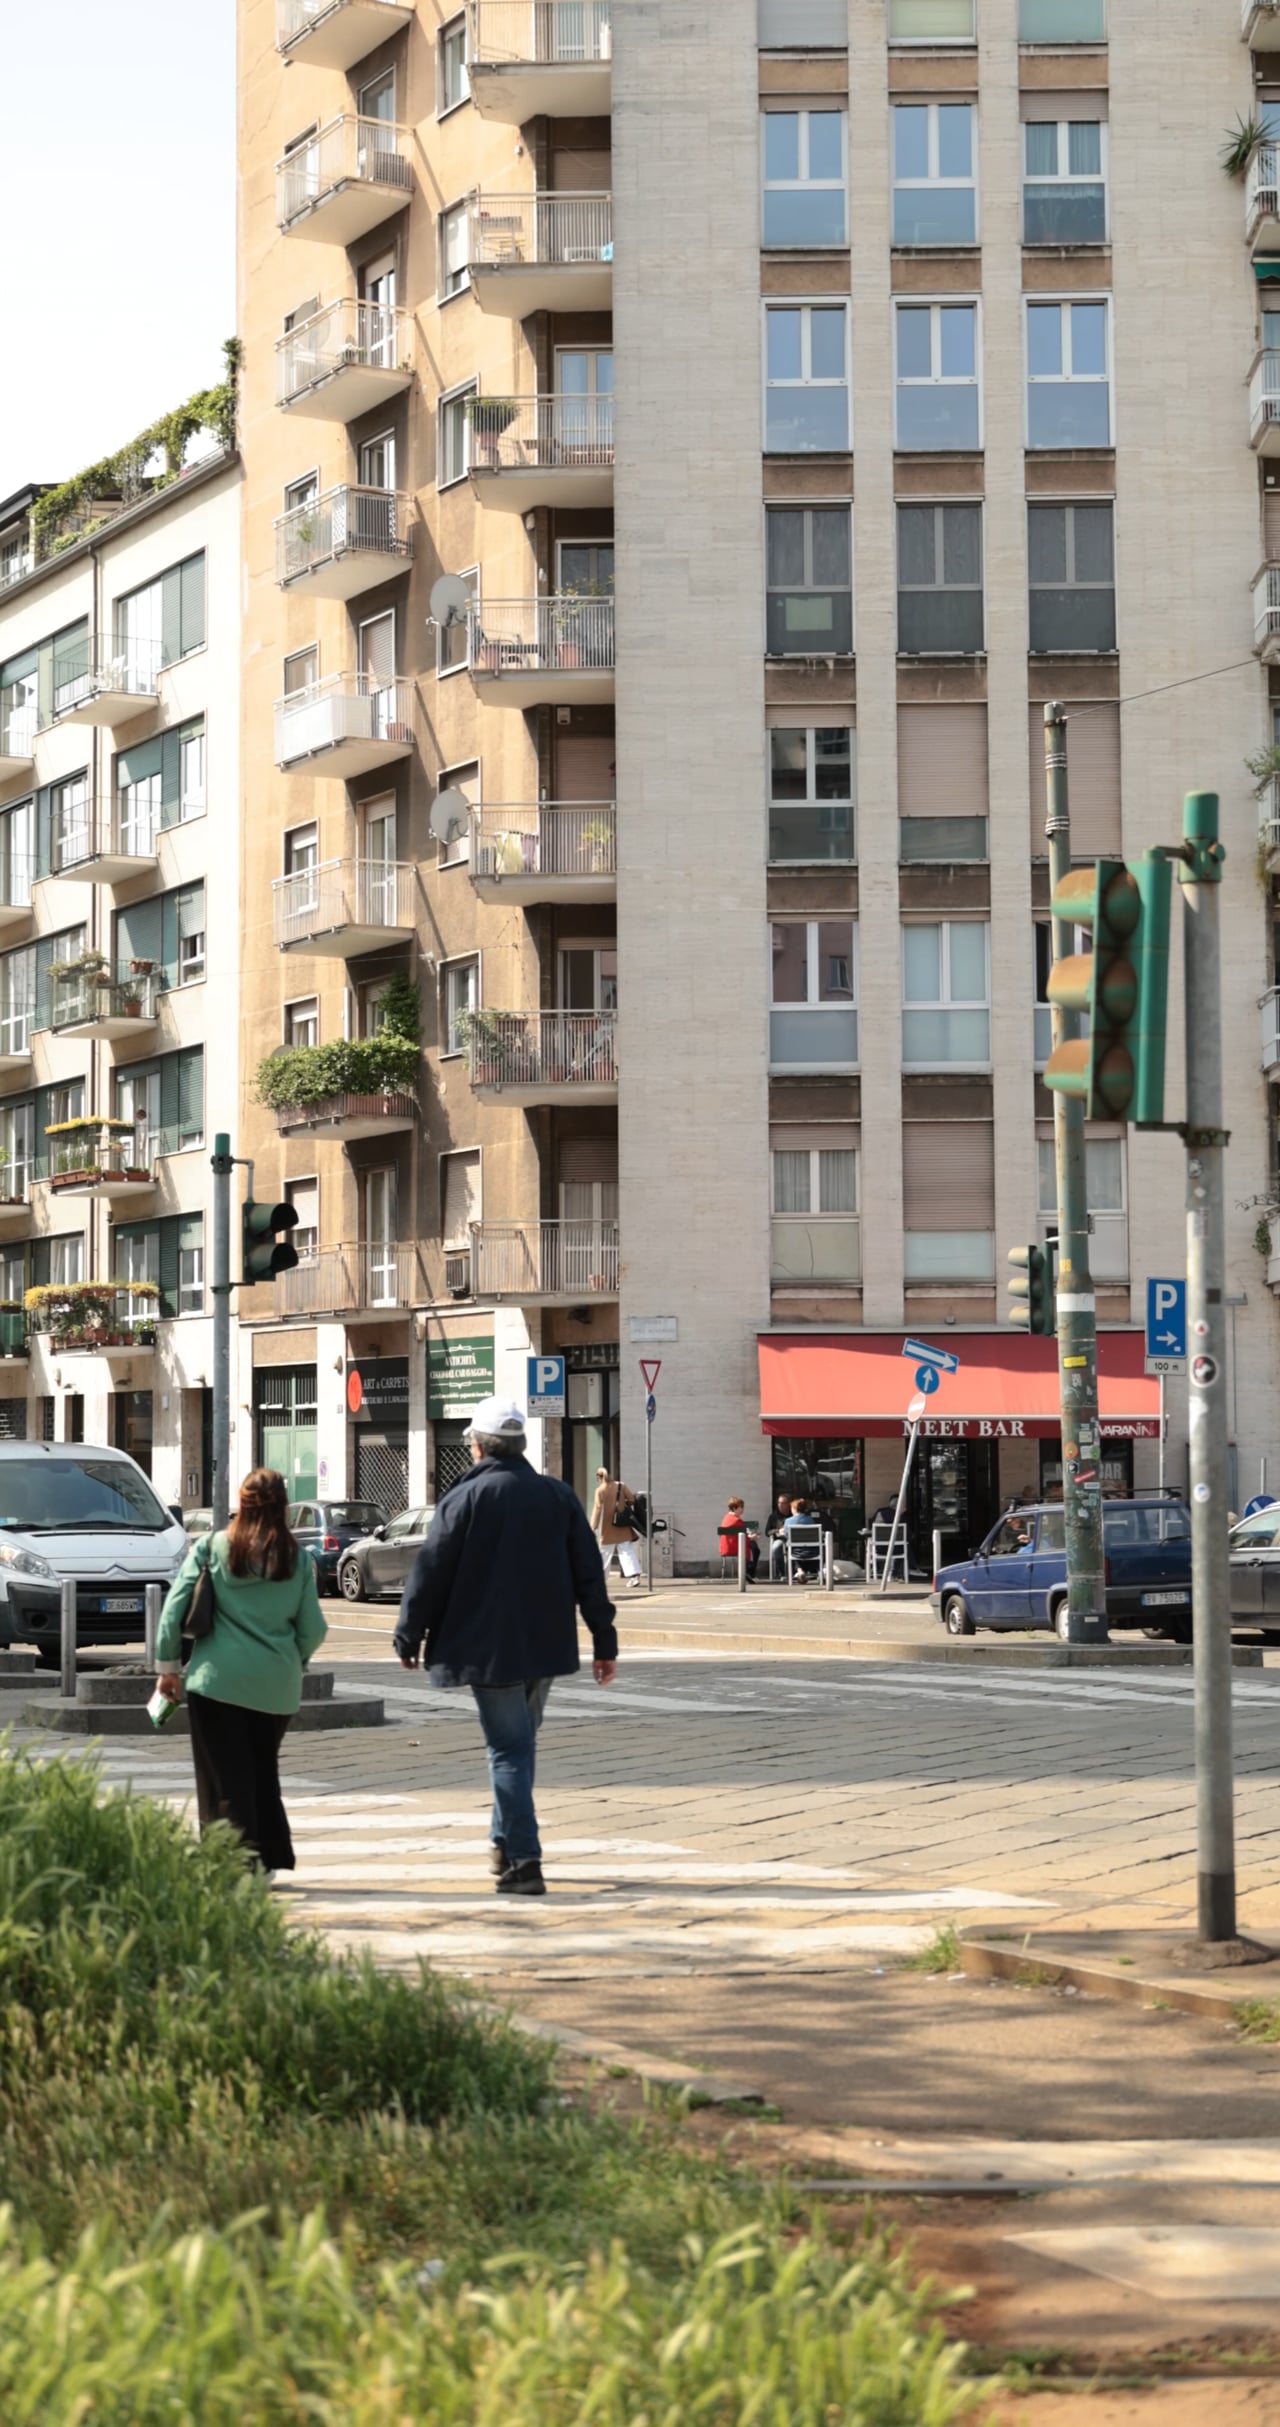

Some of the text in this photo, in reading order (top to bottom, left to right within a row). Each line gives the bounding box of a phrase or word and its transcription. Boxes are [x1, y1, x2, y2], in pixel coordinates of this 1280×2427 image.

[1155, 1283, 1178, 1321] P
[536, 1360, 560, 1393] P
[1154, 1362, 1169, 1371] 100
[902, 1420, 1026, 1437] MEET BAR
